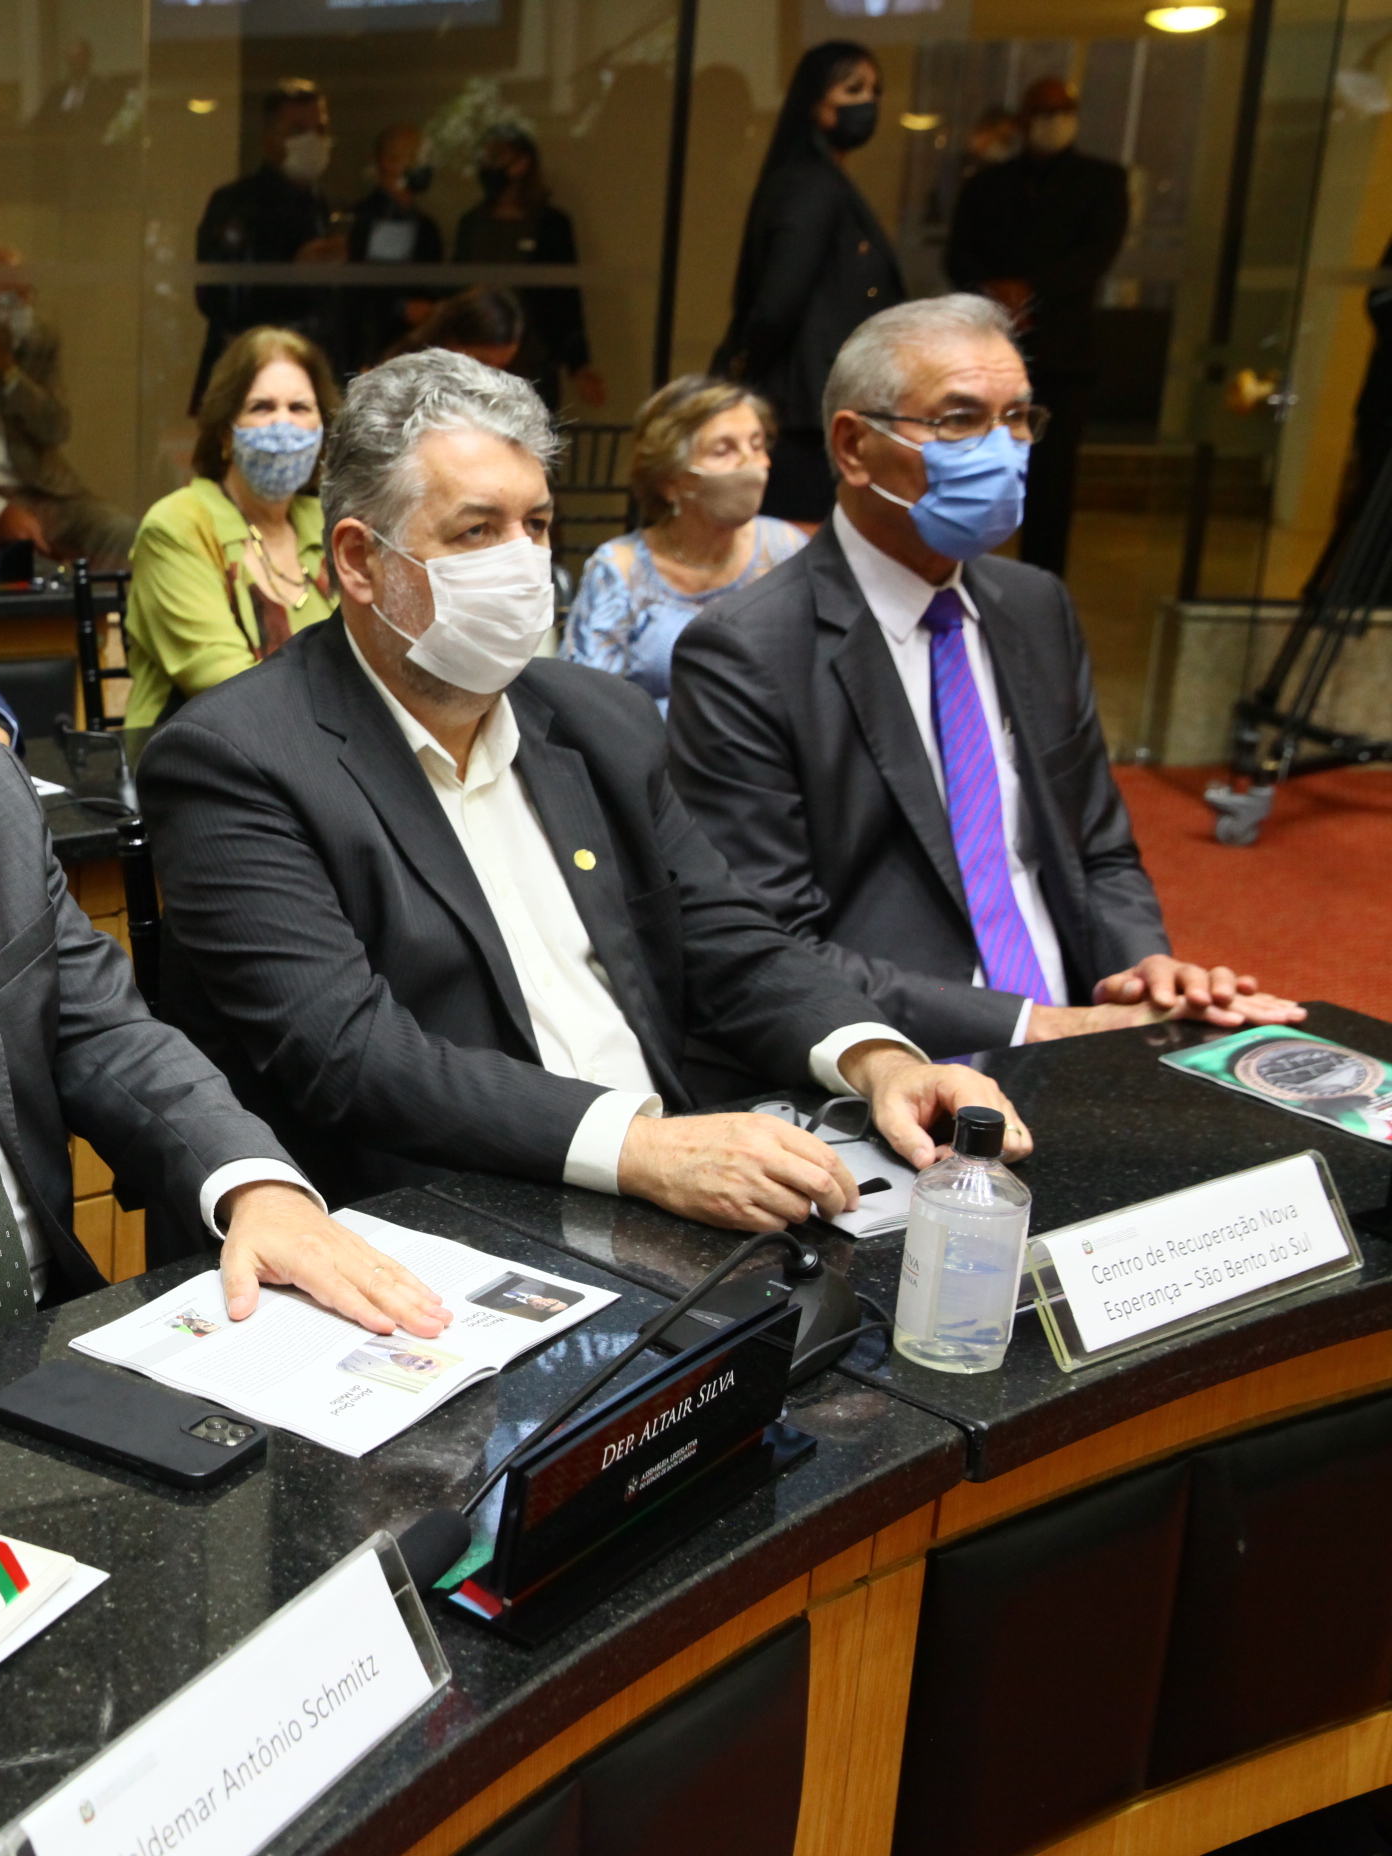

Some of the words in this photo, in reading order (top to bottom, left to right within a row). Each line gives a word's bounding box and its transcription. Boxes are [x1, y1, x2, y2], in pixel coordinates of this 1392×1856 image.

[1091, 1254, 1144, 1285] Centro
[1146, 1246, 1167, 1266] de
[1167, 1214, 1259, 1259] Recuperação
[1262, 1202, 1298, 1232] Nova
[1103, 1278, 1182, 1321] Esperança
[1194, 1265, 1223, 1291] São
[1224, 1253, 1268, 1280] Bento
[1269, 1241, 1288, 1264] do
[1289, 1231, 1313, 1258] Sul
[601, 1433, 635, 1471] DEP.
[638, 1396, 693, 1447] ALTAIR
[696, 1369, 735, 1409] SILVA
[118, 1786, 217, 1856] ldemar
[221, 1721, 304, 1801] Antônio
[303, 1652, 381, 1729] Schmitz
